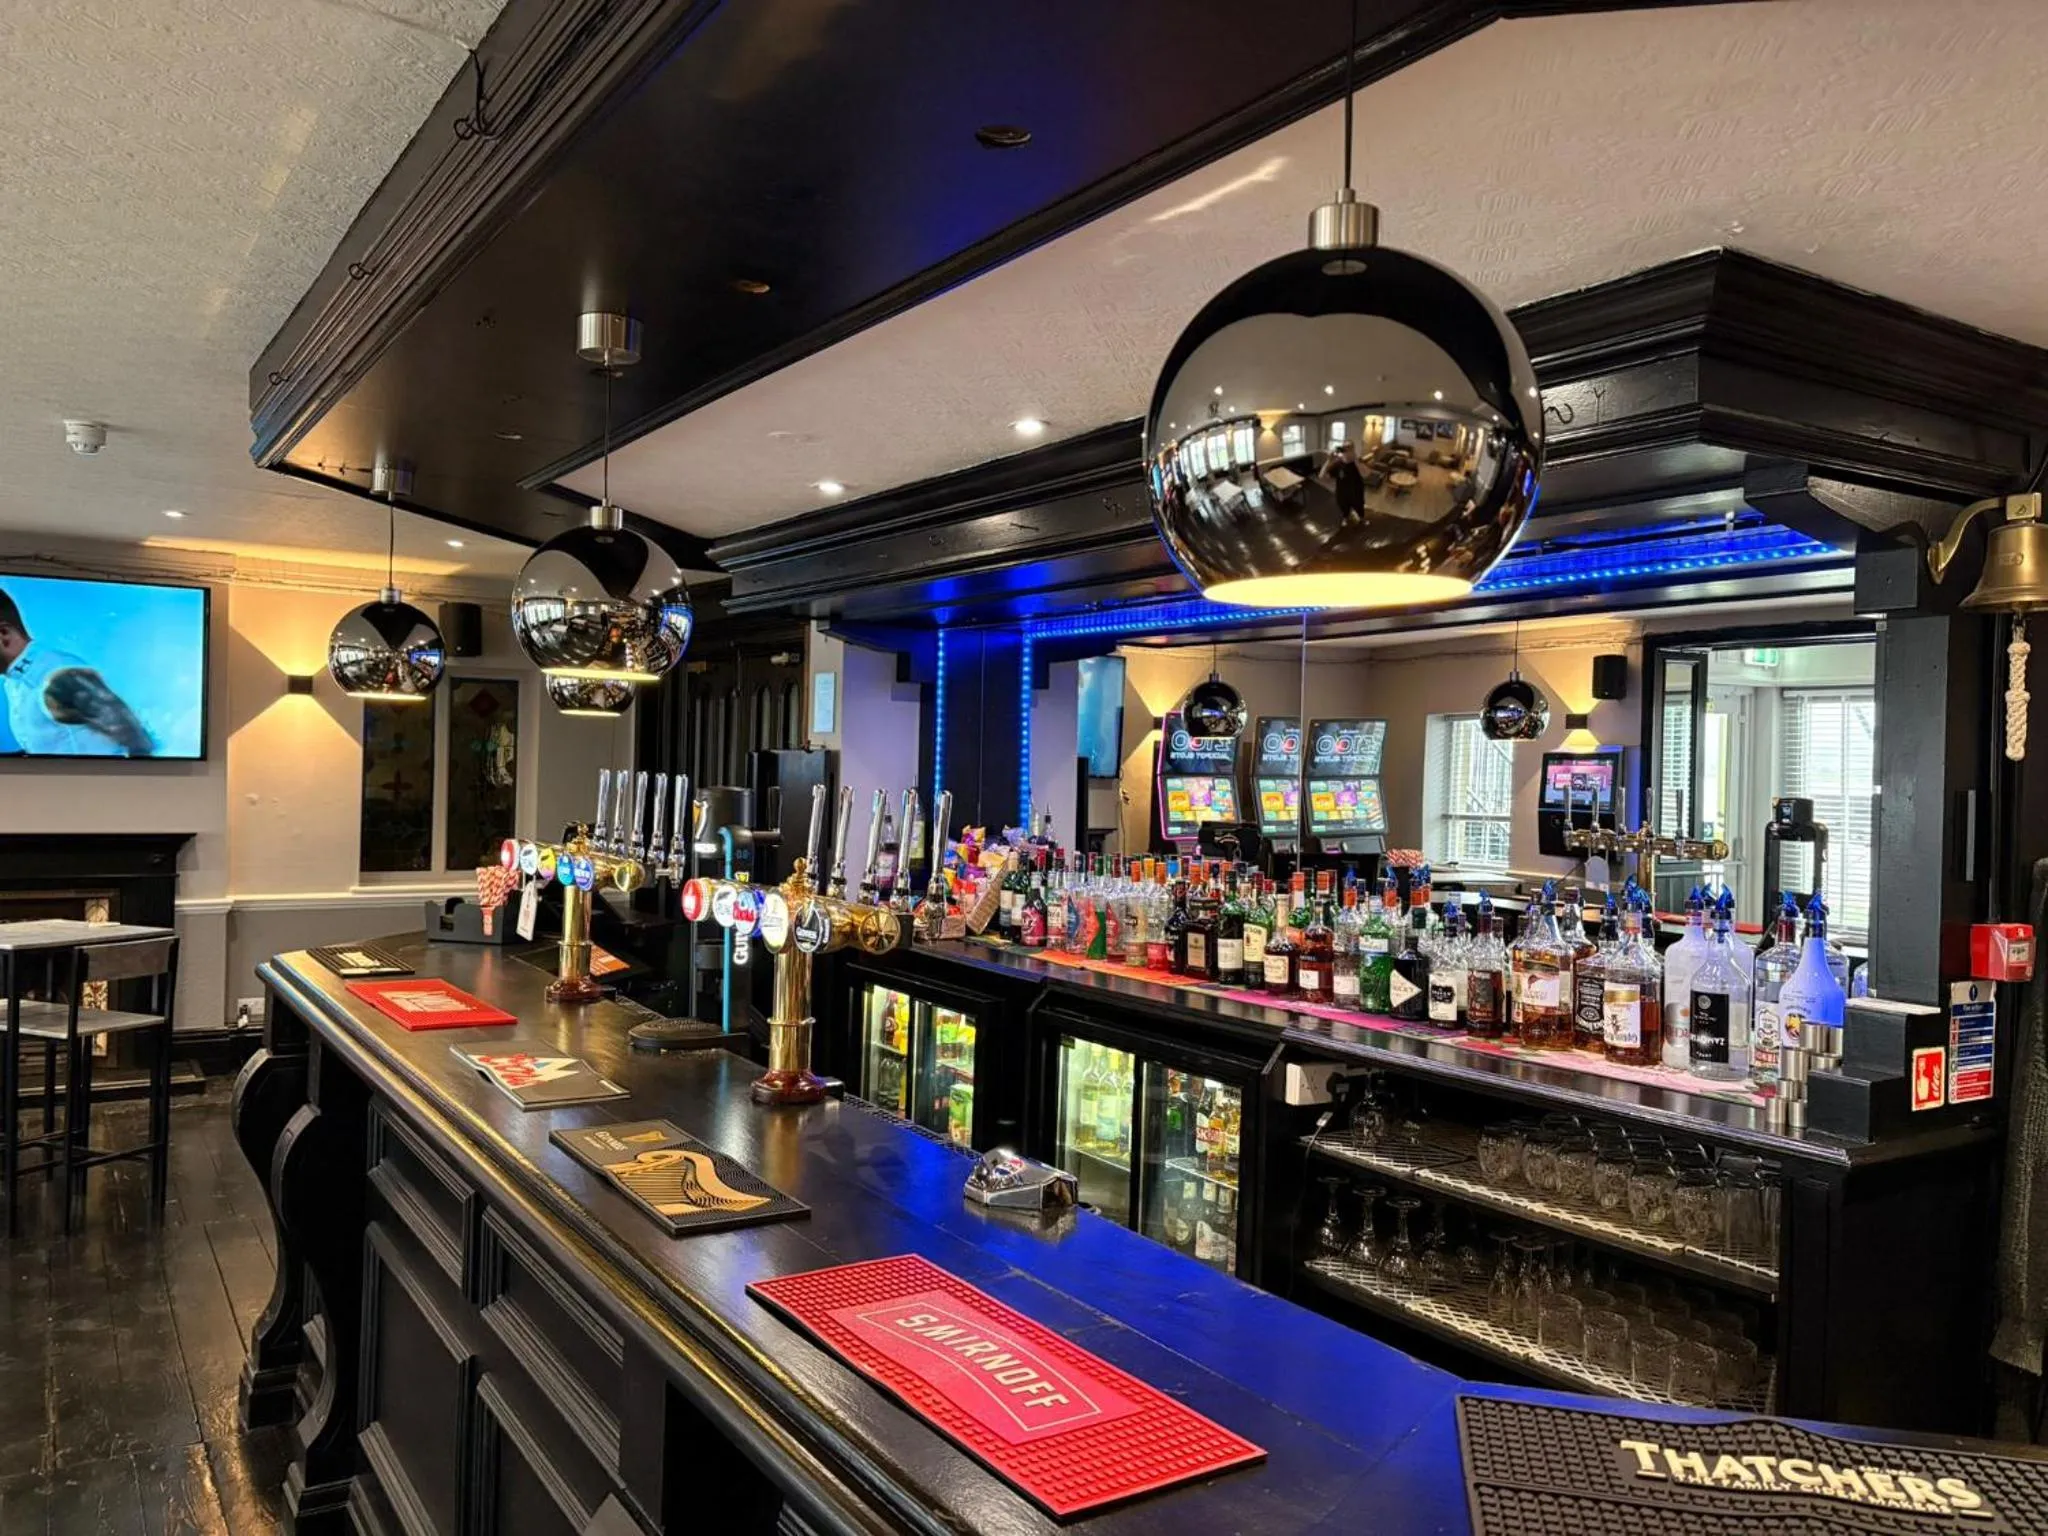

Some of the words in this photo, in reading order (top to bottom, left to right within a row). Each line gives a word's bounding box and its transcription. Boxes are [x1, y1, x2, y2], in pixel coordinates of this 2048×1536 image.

[895, 1312, 1070, 1410] SMIRNOFF
[1619, 1438, 1983, 1510] THATCHERS
[1721, 1478, 1793, 1492] FAMILY
[1800, 1483, 1863, 1501] CIDER
[1867, 1495, 1953, 1514] MAKERS
